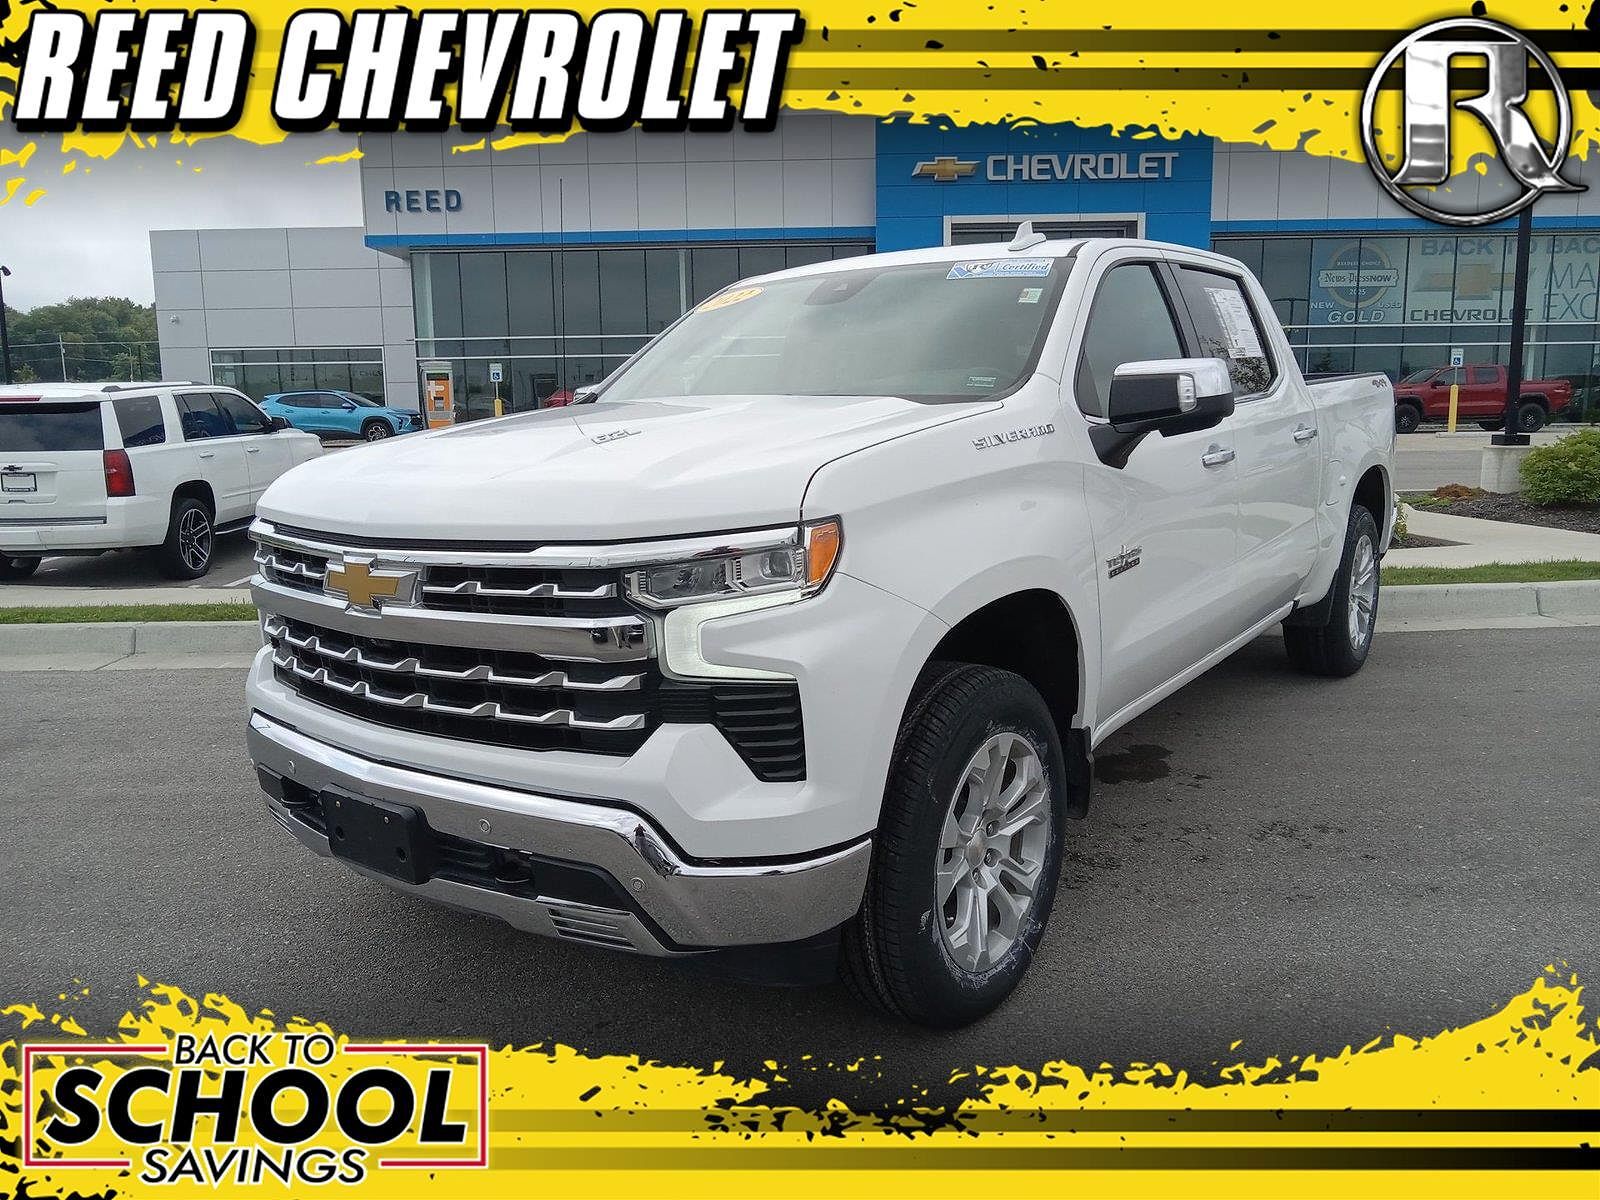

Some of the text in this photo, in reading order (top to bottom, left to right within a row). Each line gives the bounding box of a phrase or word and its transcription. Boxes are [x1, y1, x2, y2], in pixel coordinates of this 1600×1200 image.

[987, 152, 1180, 181] CHEVROLET
[384, 189, 463, 213] REED
[1421, 238, 1495, 256] BACK
[1327, 310, 1385, 323] GOLD
[1410, 308, 1533, 322] CHEVROLT
[972, 423, 1055, 450] SILVERADO
